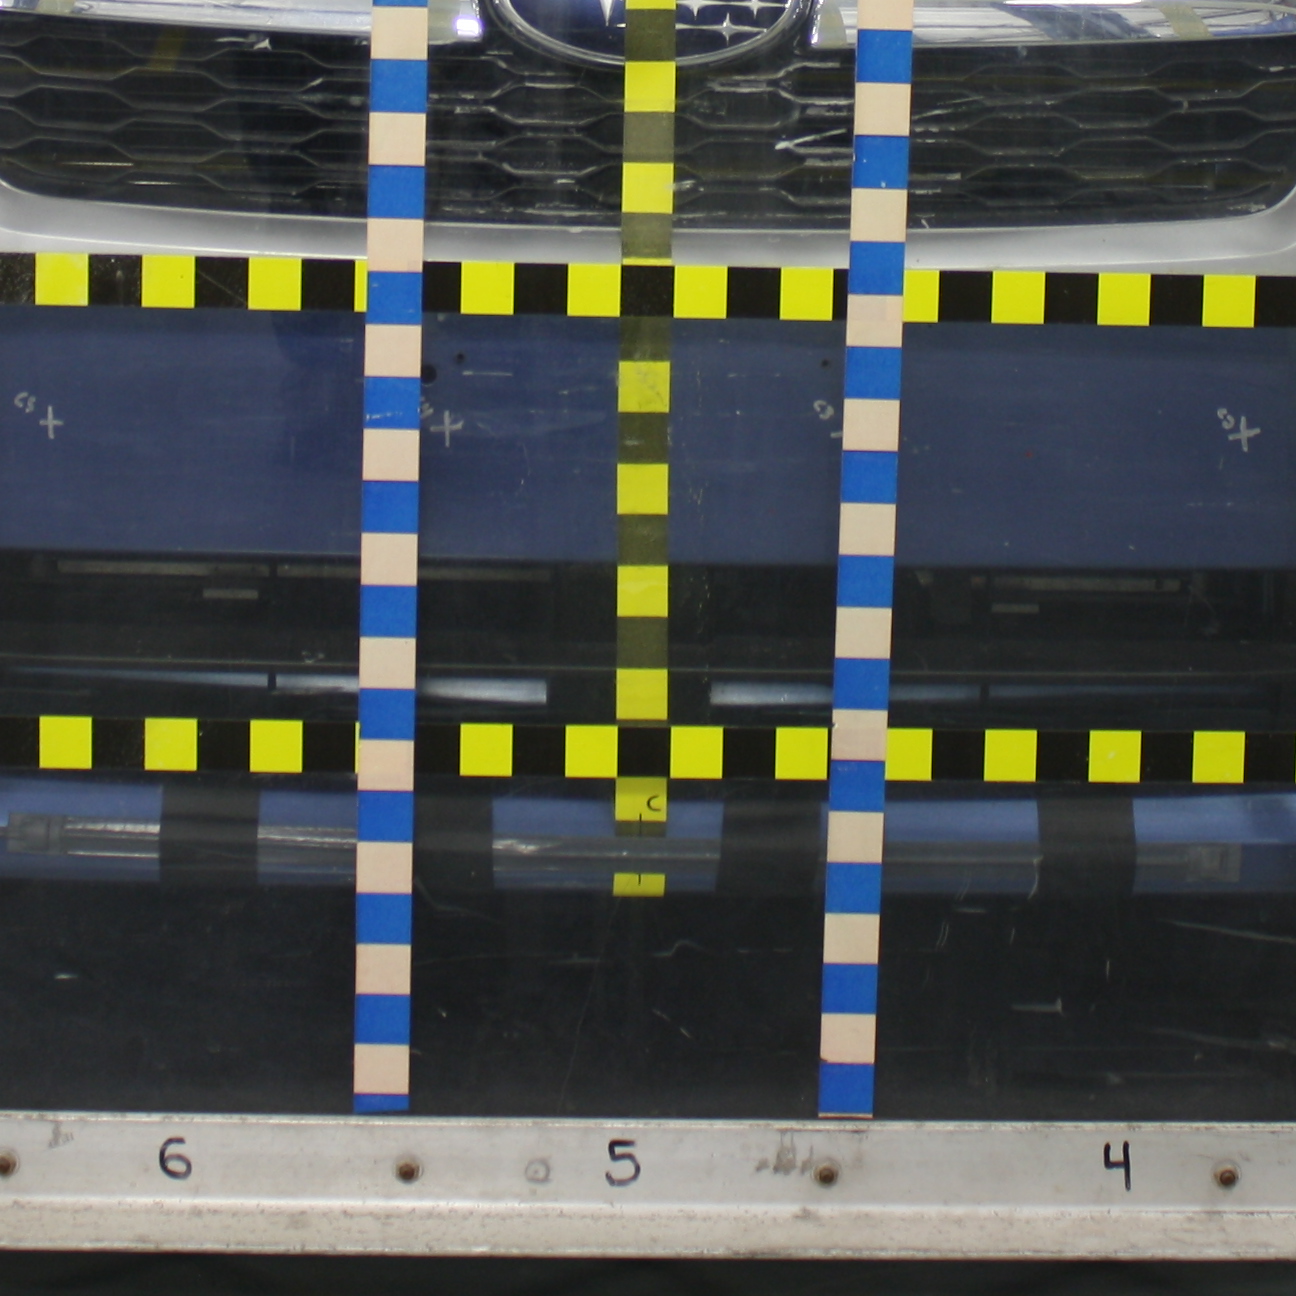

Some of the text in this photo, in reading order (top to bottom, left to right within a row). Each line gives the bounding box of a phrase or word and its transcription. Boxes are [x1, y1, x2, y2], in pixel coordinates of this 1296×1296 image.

[158, 1136, 193, 1181] 6
[604, 1138, 642, 1188] 5
[1103, 1140, 1132, 1192] 4
